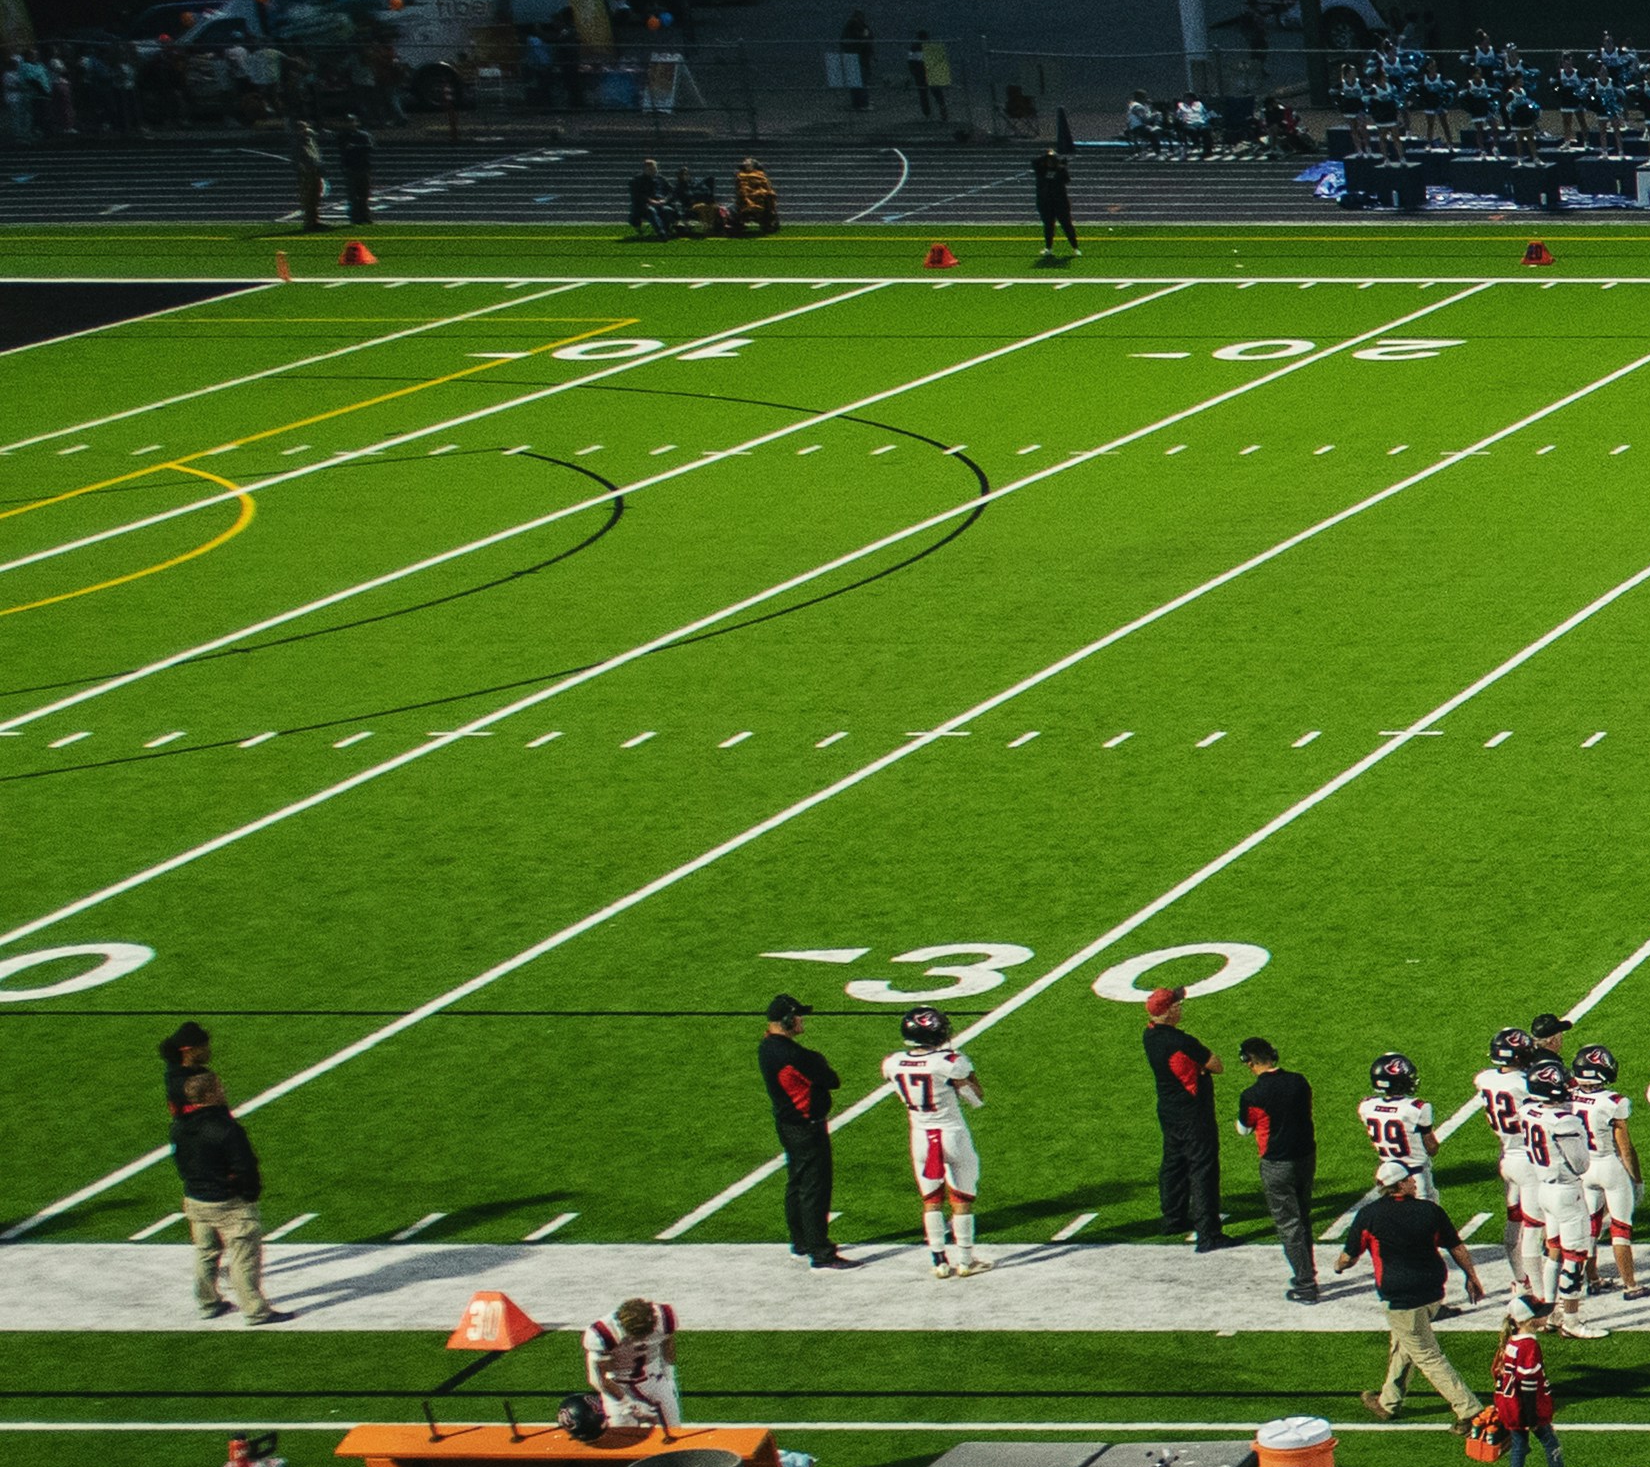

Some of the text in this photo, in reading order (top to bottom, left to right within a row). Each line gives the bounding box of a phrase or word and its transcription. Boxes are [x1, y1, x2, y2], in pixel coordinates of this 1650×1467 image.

[845, 942, 1269, 1003] 30
[895, 1072, 937, 1112] 17
[1367, 1119, 1412, 1158] 29
[465, 1300, 504, 1341] 30
